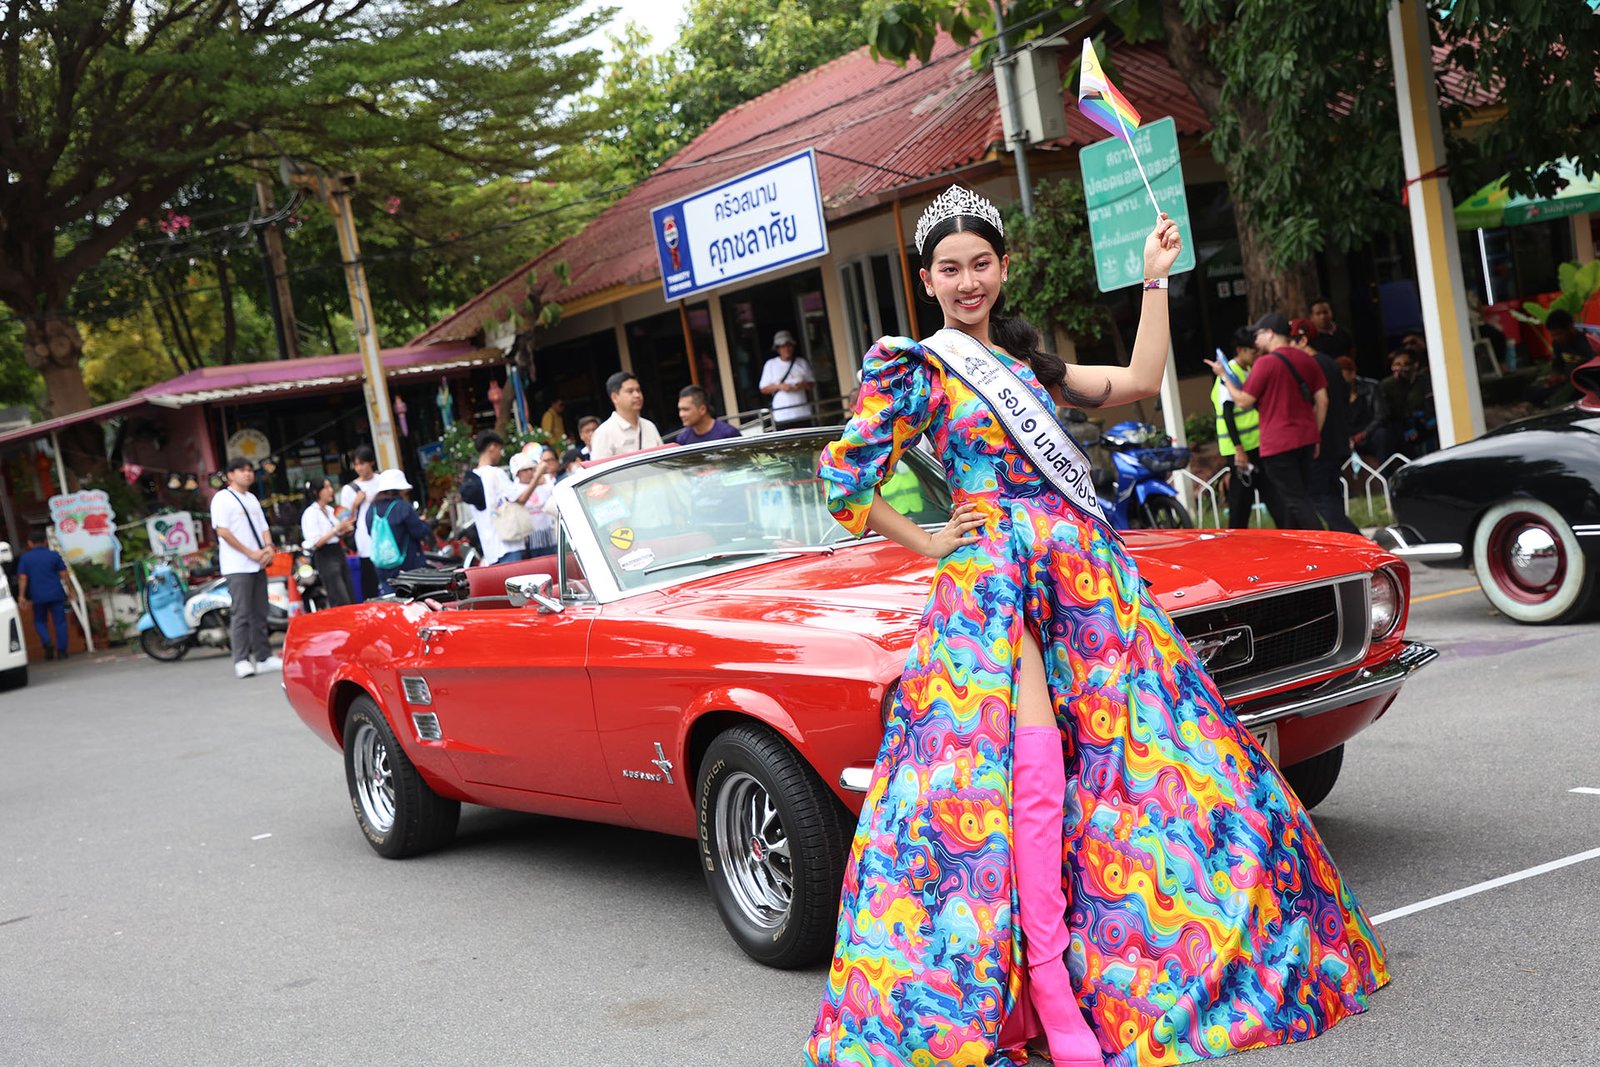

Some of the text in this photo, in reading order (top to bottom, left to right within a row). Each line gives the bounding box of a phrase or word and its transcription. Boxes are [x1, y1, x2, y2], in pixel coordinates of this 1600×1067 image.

[714, 181, 778, 223] ครัวสนาม
[708, 211, 798, 276] ศุภชลาศัย
[998, 387, 1026, 417] รอง
[701, 758, 726, 873] BFGoodrich
